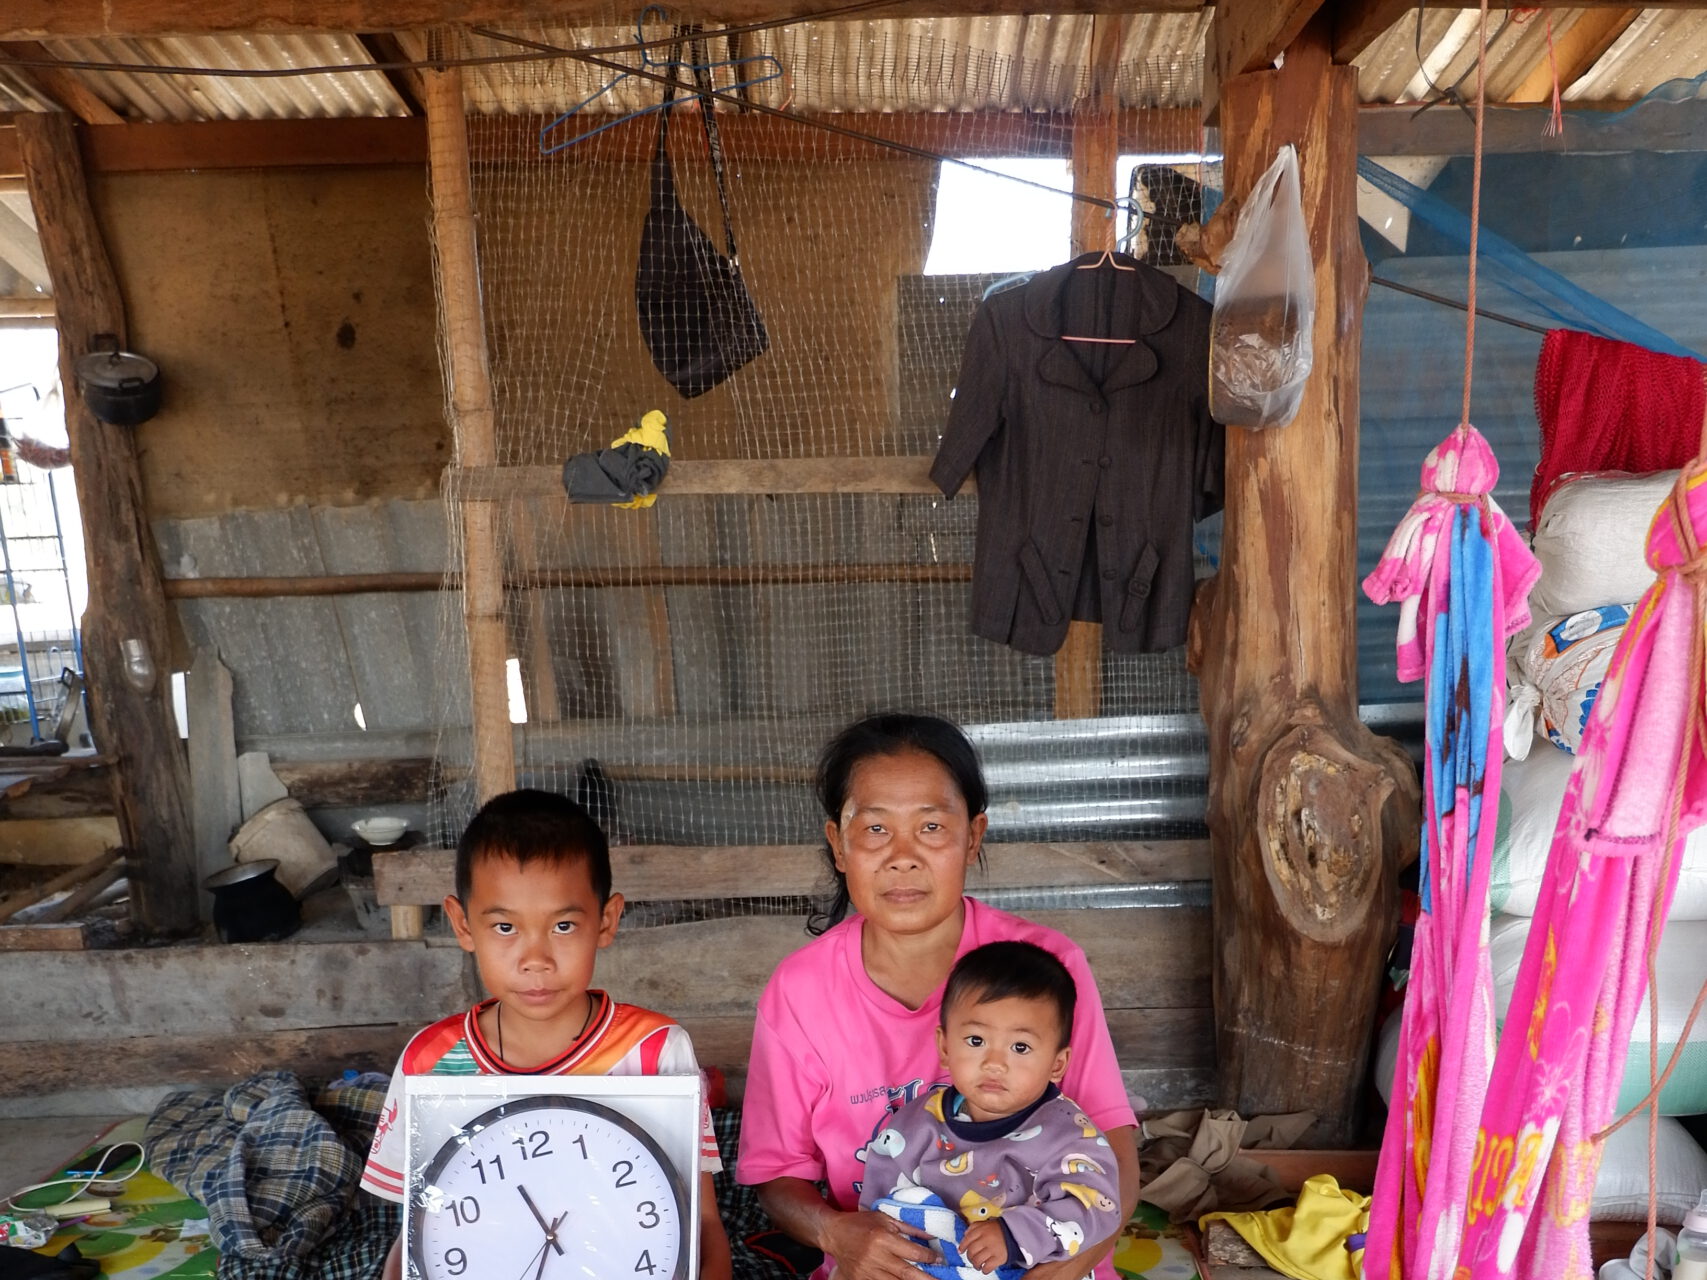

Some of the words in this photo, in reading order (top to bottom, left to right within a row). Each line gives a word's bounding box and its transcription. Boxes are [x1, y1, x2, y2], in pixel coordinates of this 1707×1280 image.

[512, 1130, 553, 1161] 12
[572, 1134, 589, 1160] 1
[471, 1154, 505, 1185] 11
[612, 1160, 637, 1188] 2
[445, 1195, 481, 1227] 10
[636, 1201, 661, 1229] 3
[444, 1247, 468, 1275] 9
[634, 1250, 657, 1276] 4
